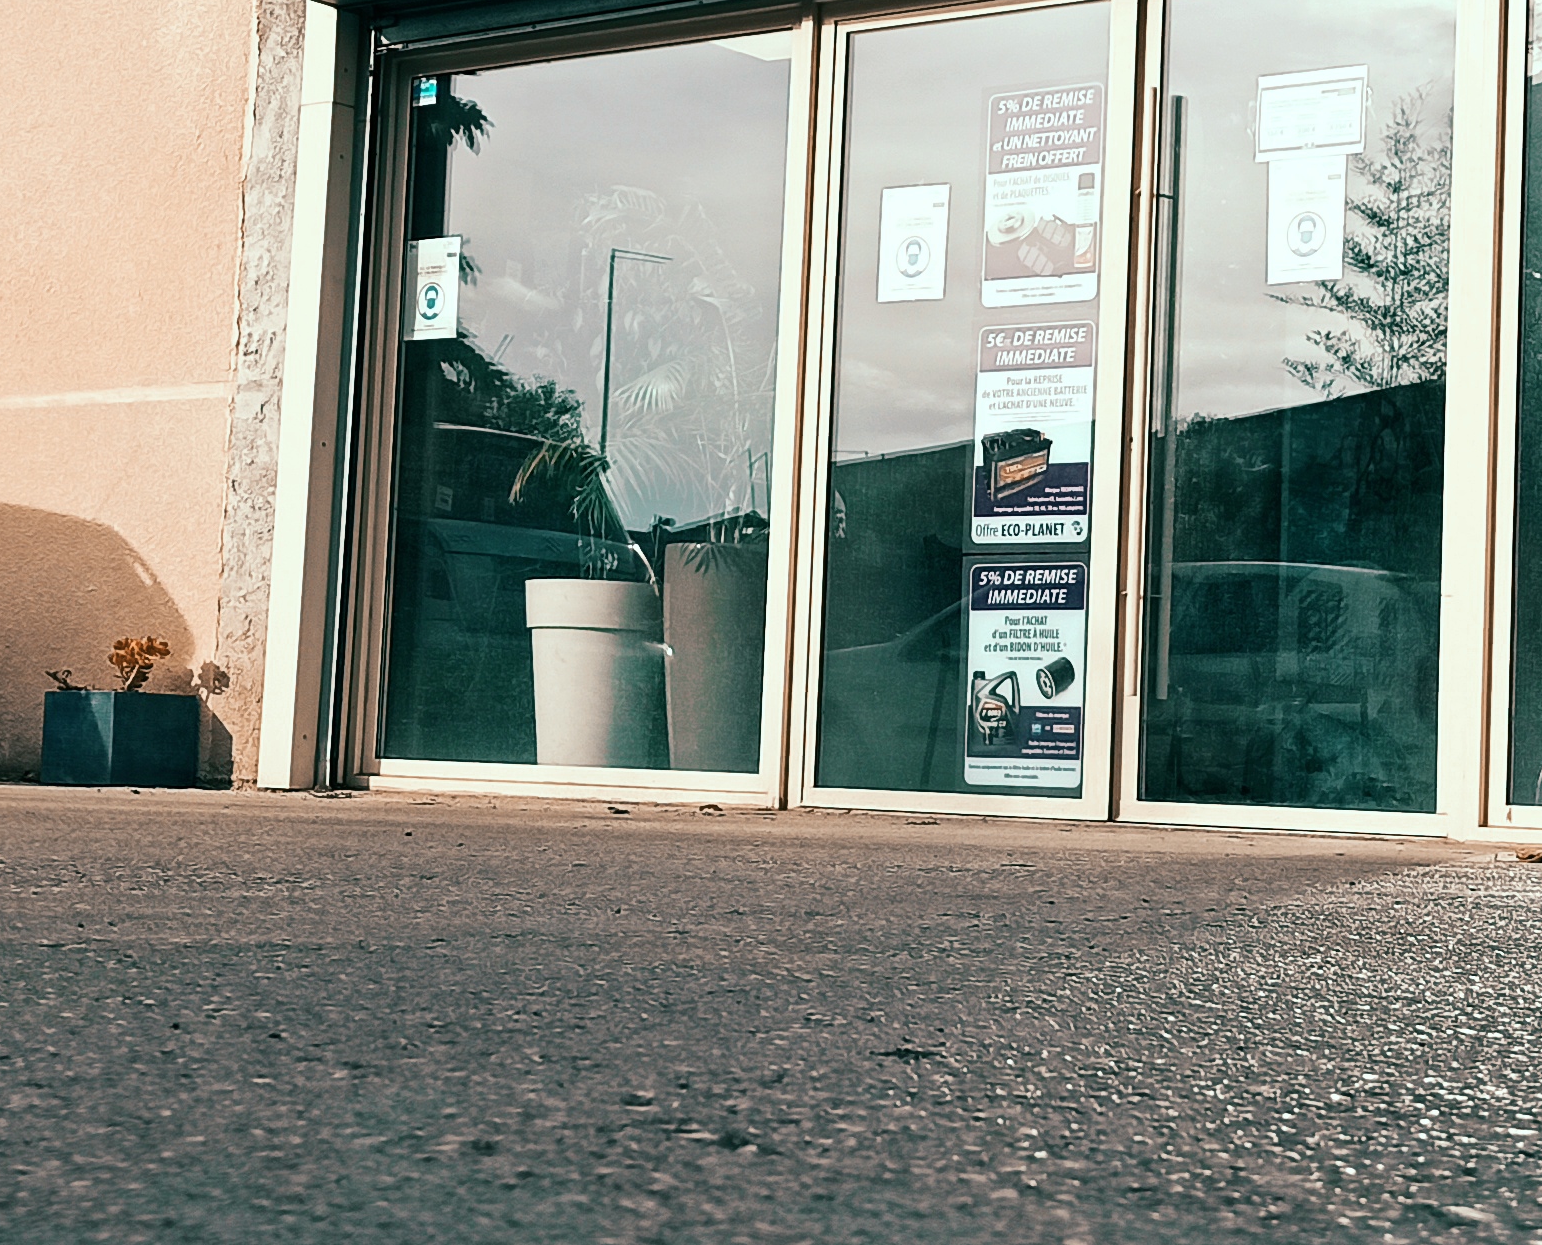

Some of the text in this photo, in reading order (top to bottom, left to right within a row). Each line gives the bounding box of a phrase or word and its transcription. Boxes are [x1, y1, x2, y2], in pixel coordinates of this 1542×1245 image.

[997, 89, 1095, 115] 5% DE REMISE
[1005, 109, 1085, 132] IMMEDIATE
[1003, 134, 1023, 150] UN
[1022, 127, 1098, 149] NETTOYANT
[1001, 147, 1087, 170] FREIN OFFERT
[1012, 330, 1034, 346] DE
[1034, 327, 1087, 345] REMISE
[995, 347, 1076, 366] IMMEDIATE
[1006, 376, 1023, 386] Pour
[1033, 374, 1063, 385] REPRISE
[981, 384, 1088, 399] de VOTRE ANCIENNE BATTERIE
[988, 402, 997, 410] et
[975, 522, 1065, 537] Offre ECO-PLANET
[979, 569, 1078, 586] 5% DE REMISE
[987, 588, 1067, 605] IMMEDIATE
[1004, 615, 1021, 626] Pour
[991, 629, 1008, 639] d'un
[1009, 628, 1031, 639] FILTRE
[1038, 628, 1060, 639] HUILE
[983, 643, 992, 652] et
[992, 642, 1008, 652] d'un
[1009, 641, 1032, 652] BIDON
